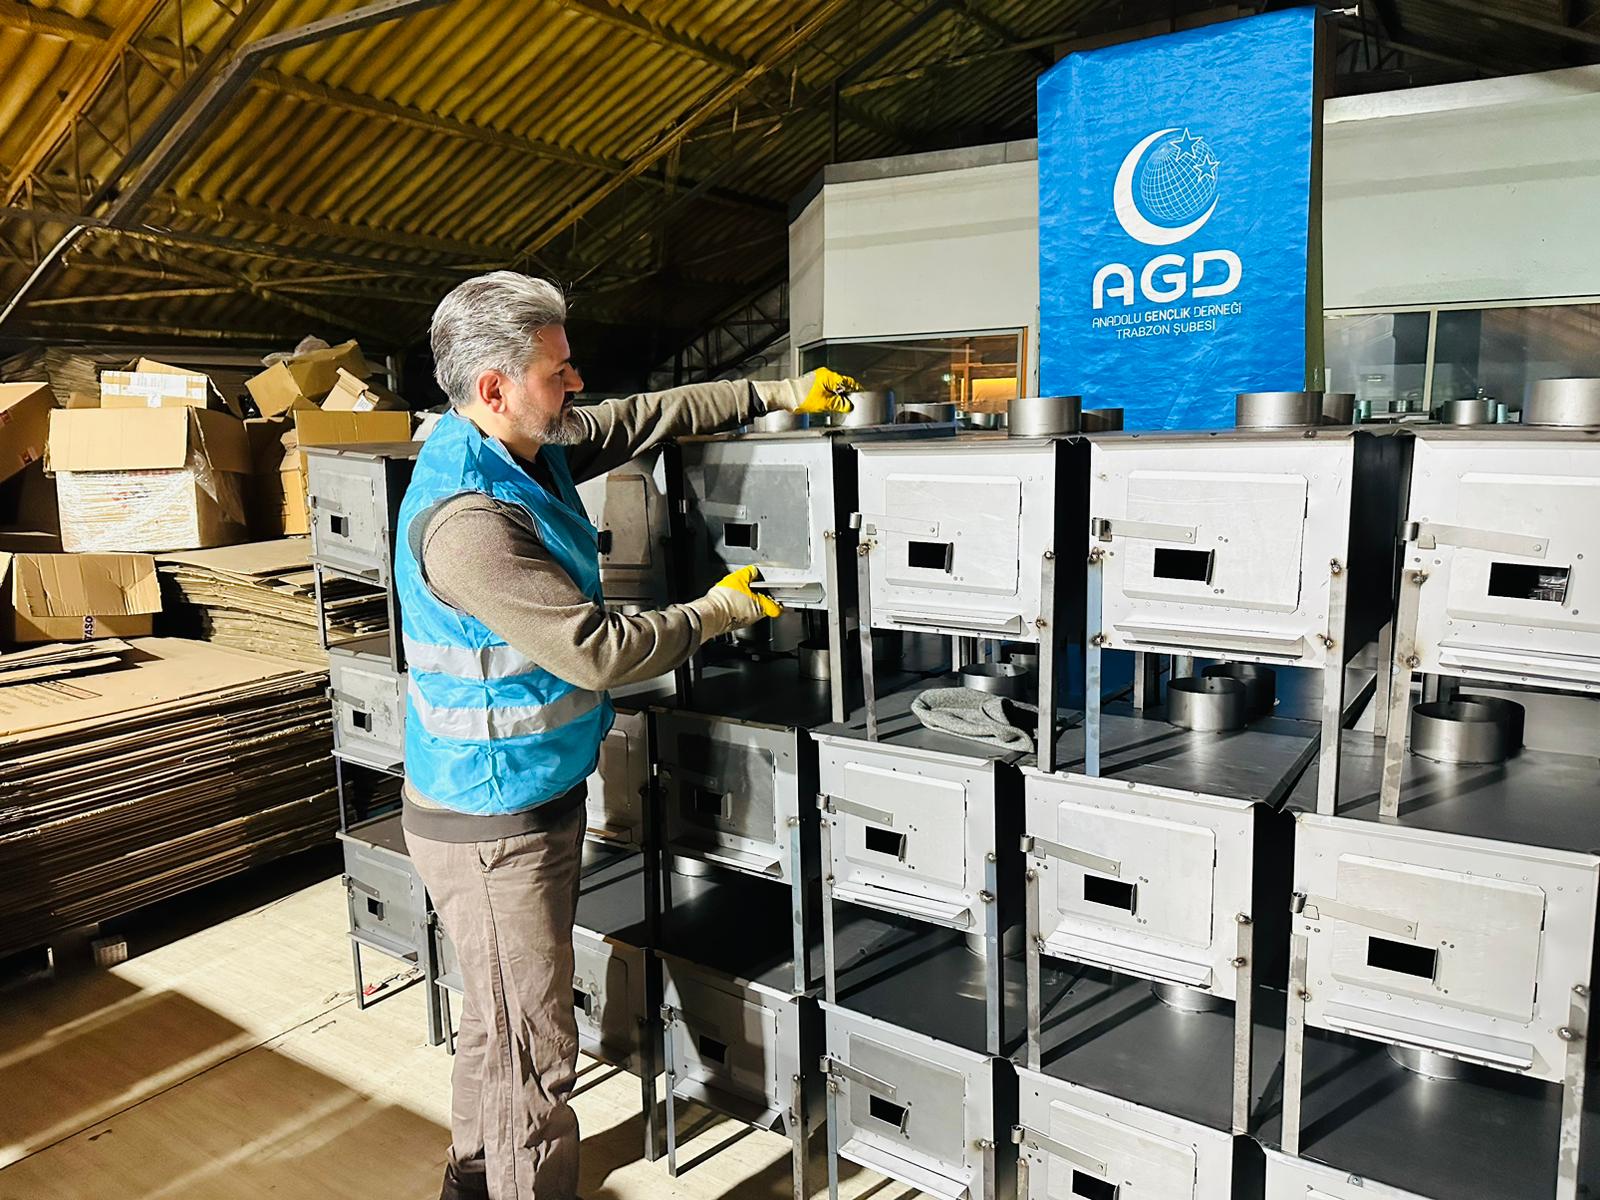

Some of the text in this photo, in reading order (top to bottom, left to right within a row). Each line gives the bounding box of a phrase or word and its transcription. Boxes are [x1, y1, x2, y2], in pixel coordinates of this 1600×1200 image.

[1092, 249, 1243, 310] AGD
[1092, 312, 1142, 329] ANADOLU
[1116, 318, 1216, 339] TRABZON ŞUBESİ
